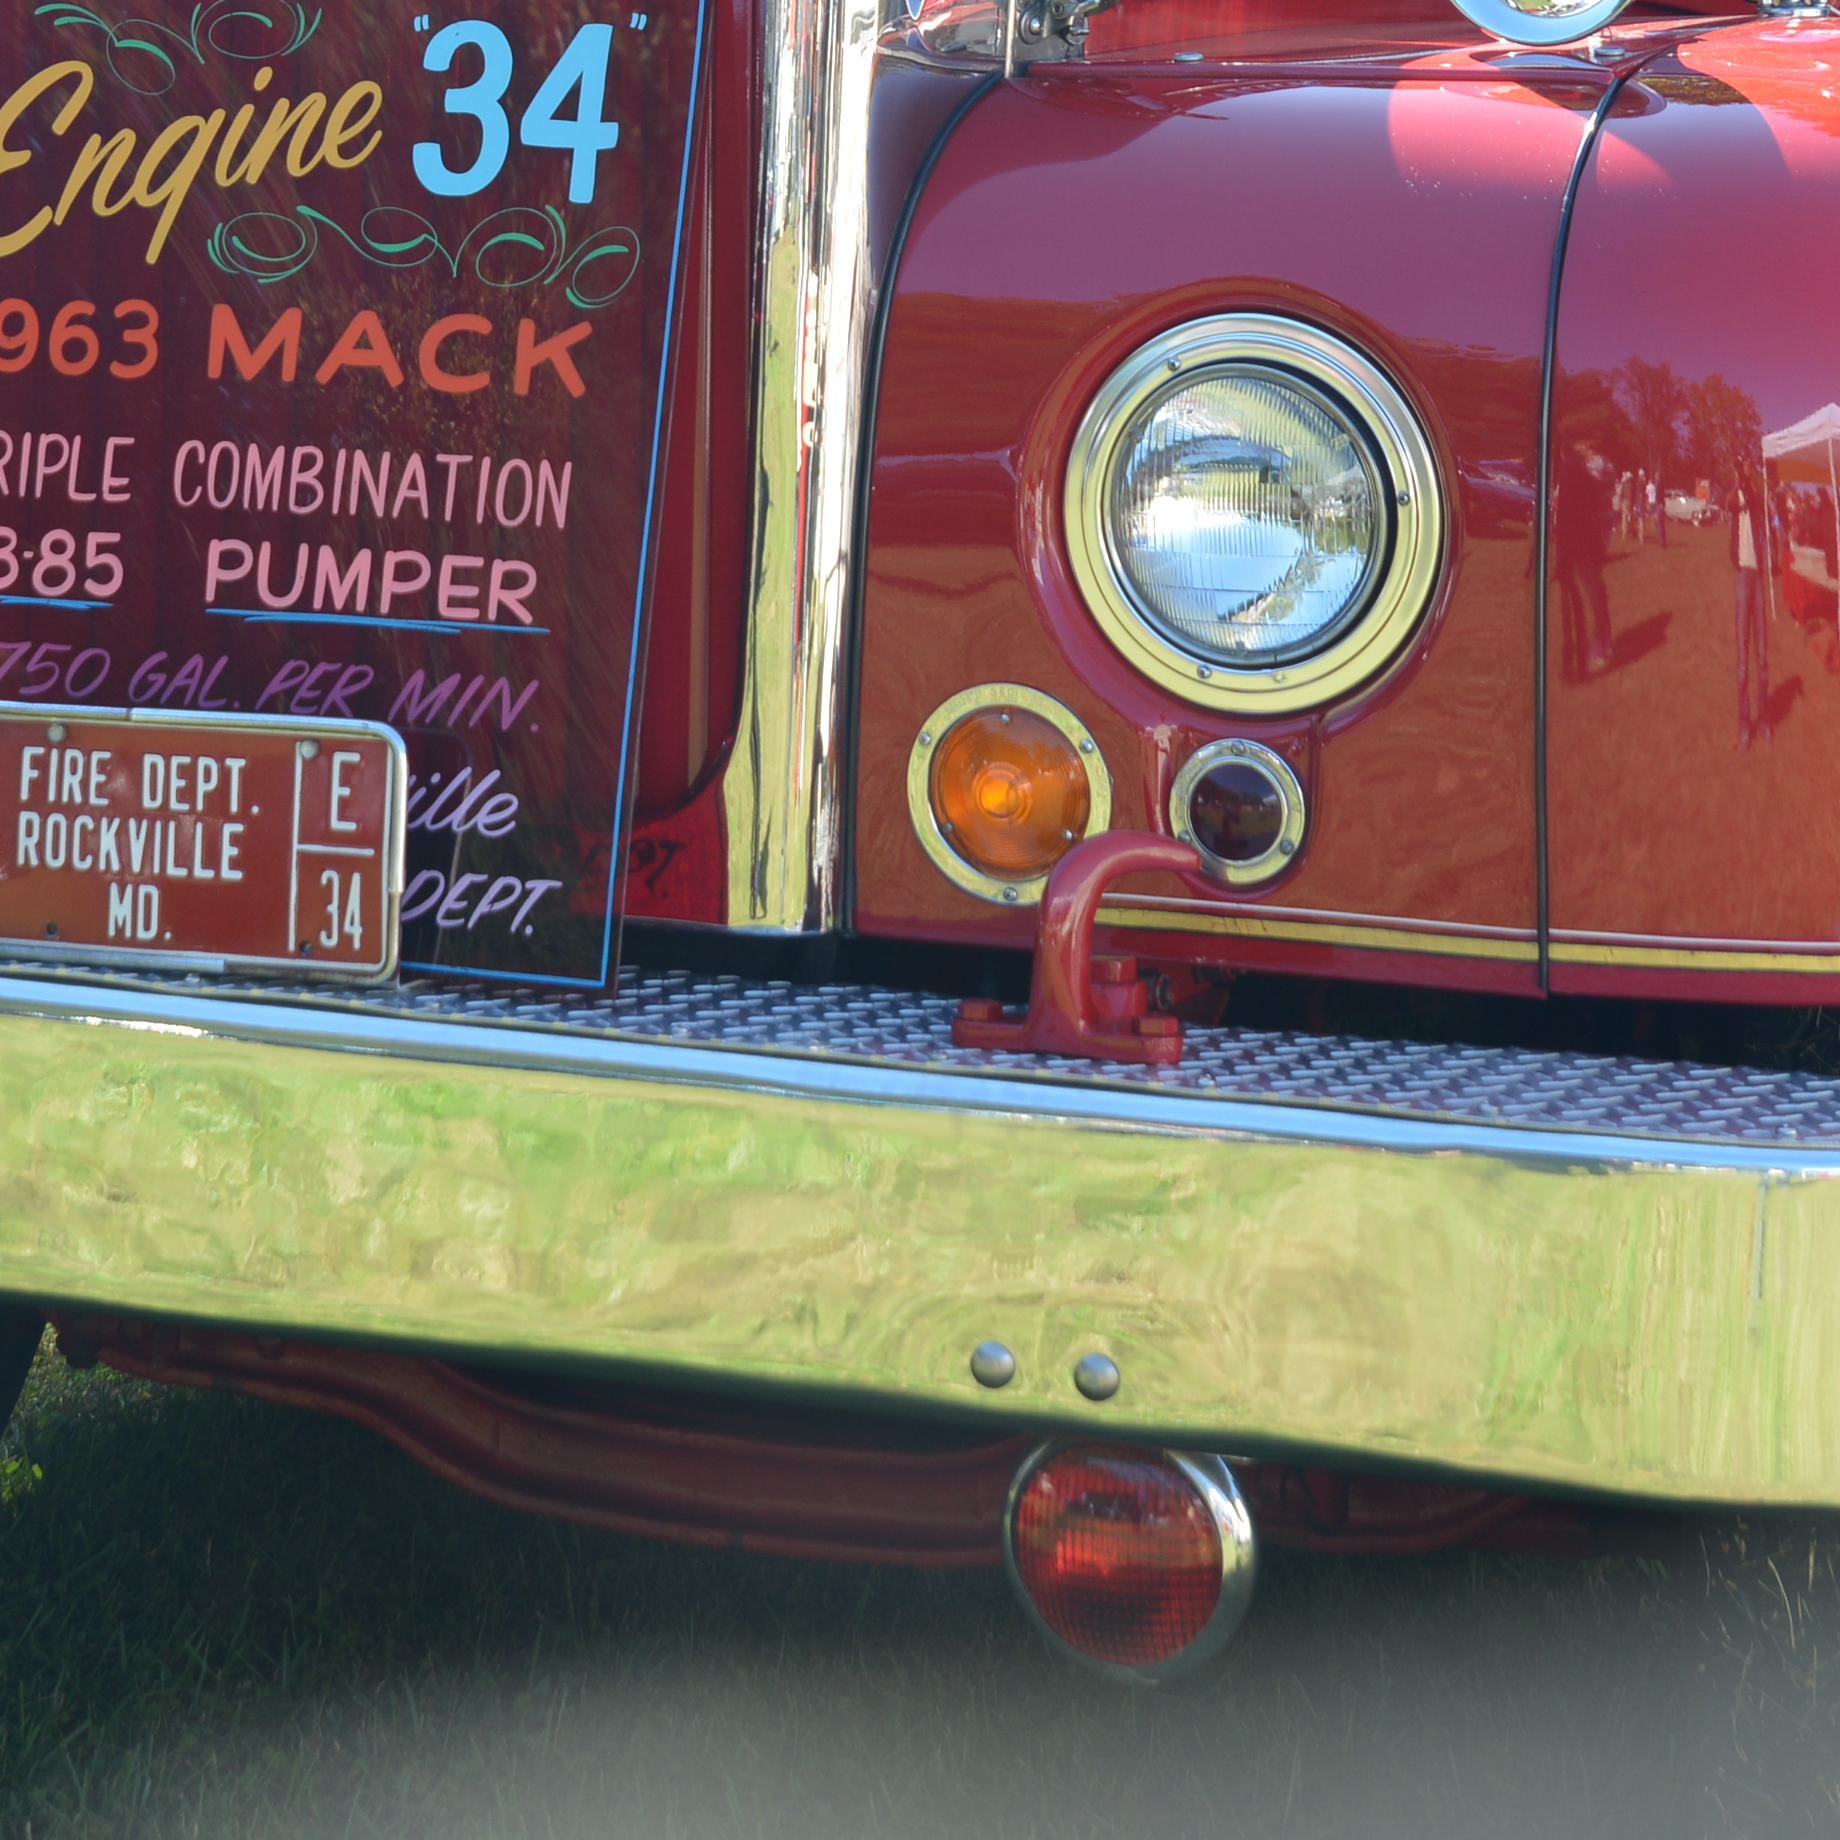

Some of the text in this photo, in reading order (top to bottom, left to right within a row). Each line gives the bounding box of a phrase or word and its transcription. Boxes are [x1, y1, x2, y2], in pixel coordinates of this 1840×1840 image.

[206, 302, 593, 399] MACK
[172, 439, 572, 530] COMBINATION
[204, 537, 538, 625] PUMPER
[127, 649, 240, 710] GAL.
[255, 659, 375, 719] PER
[387, 668, 540, 733] MIN.
[18, 744, 112, 808] FIRE
[141, 752, 260, 816] DEPT.
[327, 750, 362, 831] E
[16, 810, 245, 881] ROCKVILLE
[107, 881, 172, 941] MD.
[318, 868, 362, 952] 34
